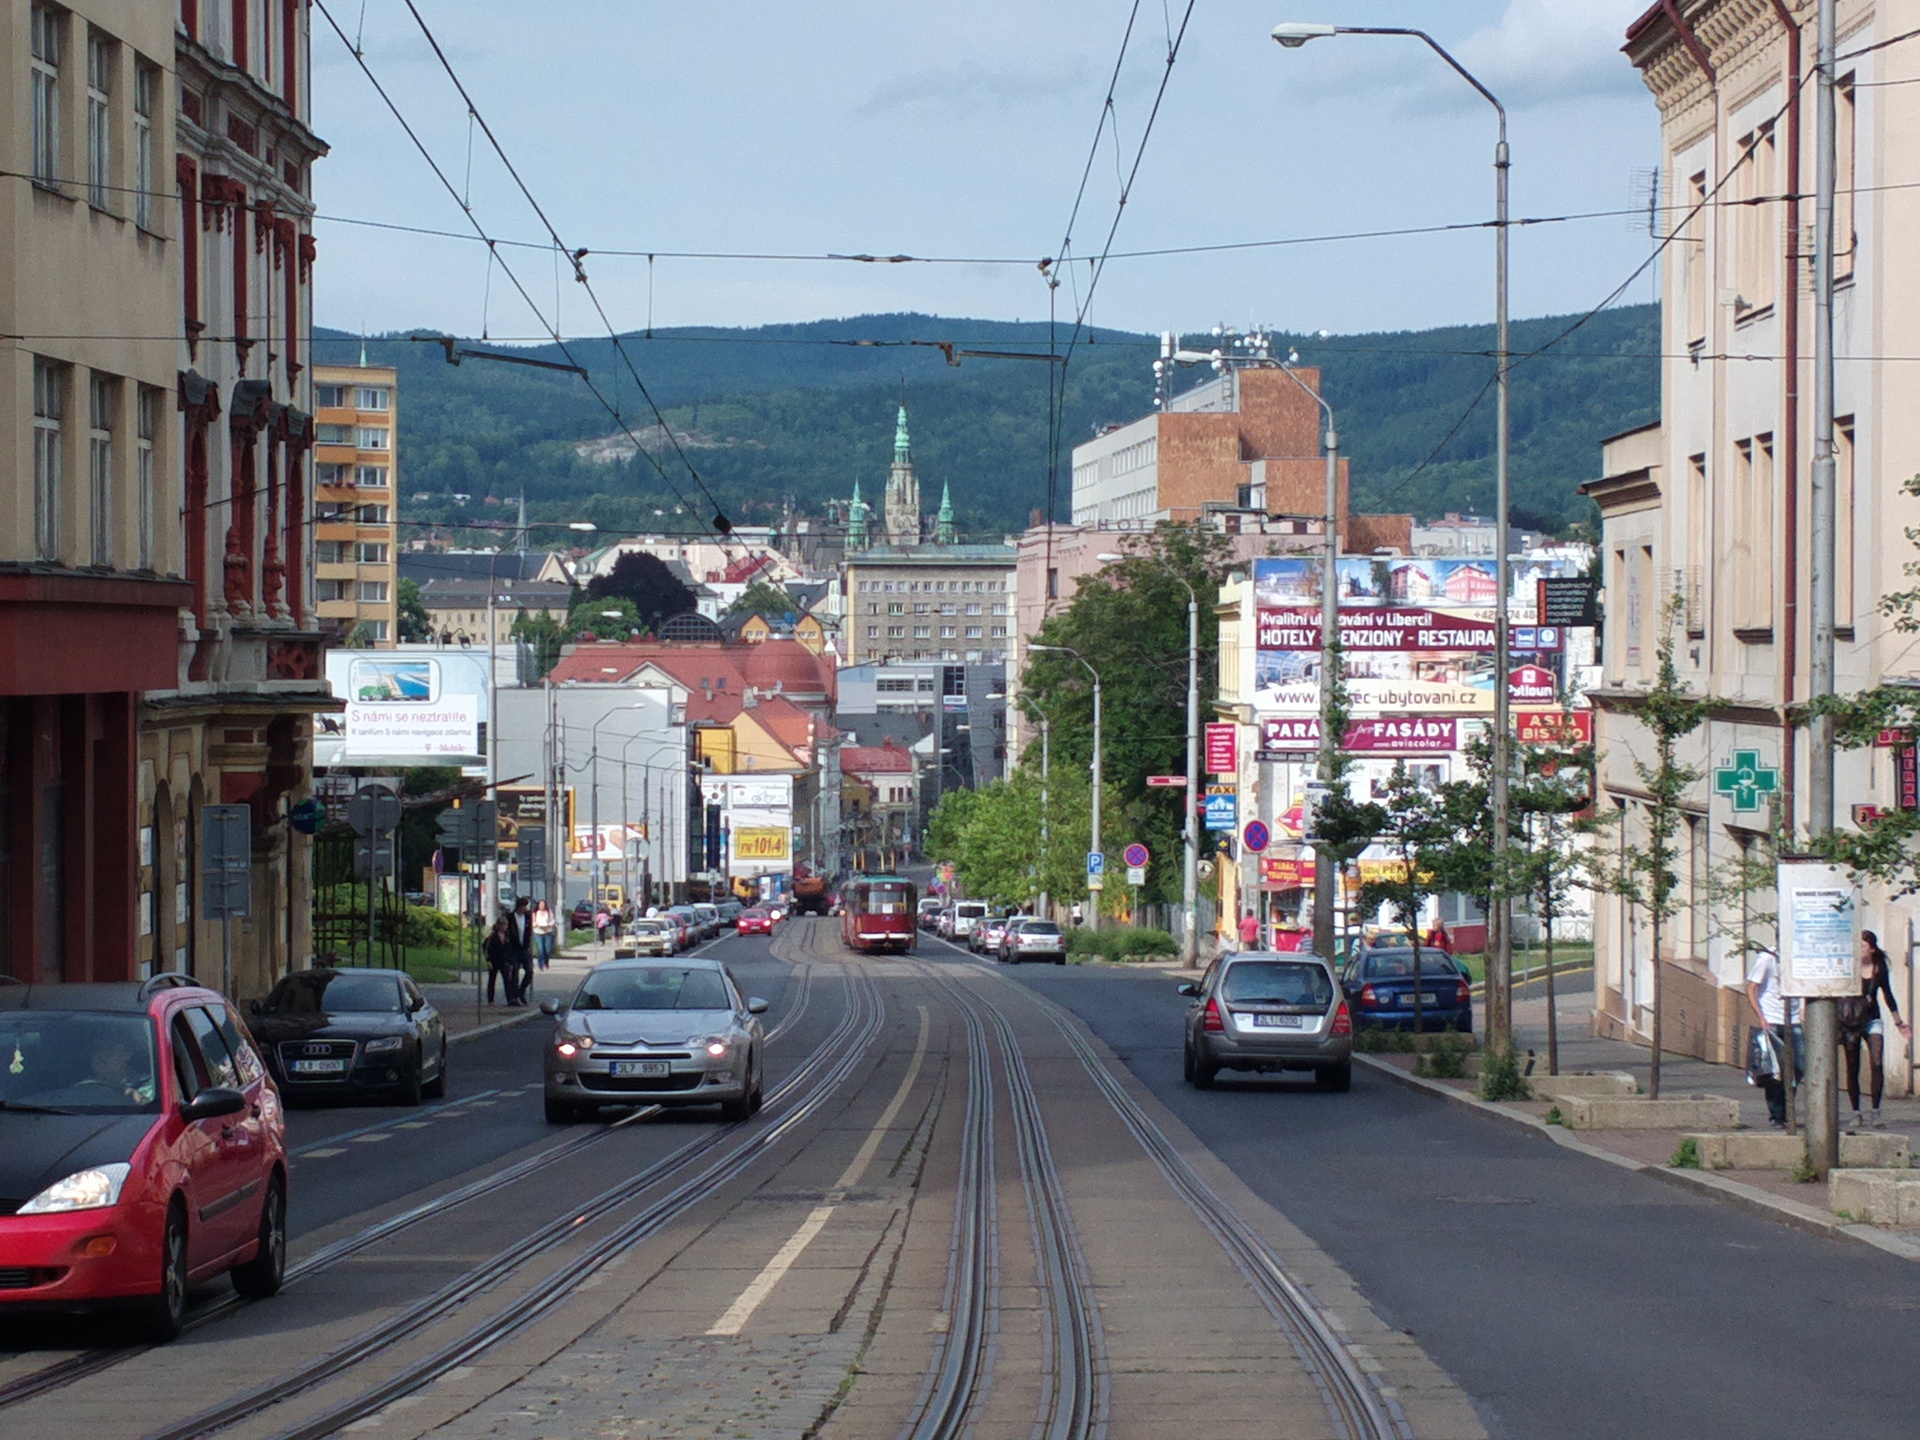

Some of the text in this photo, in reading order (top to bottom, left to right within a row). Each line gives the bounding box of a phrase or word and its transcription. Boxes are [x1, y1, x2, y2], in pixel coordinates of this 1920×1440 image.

[1097, 519, 1147, 532] HOT
[1260, 612, 1307, 626] Kvalitní
[1376, 615, 1383, 626] v
[1386, 612, 1433, 627] Liberci!
[1473, 610, 1497, 620] +42
[1260, 629, 1317, 646] HOTELY
[1338, 629, 1405, 646] ENZIONY
[351, 710, 360, 723] S
[363, 711, 393, 723] námi
[395, 713, 409, 723] se
[1267, 719, 1320, 738] PARÁ
[1373, 719, 1453, 738] FASÁDY
[1206, 785, 1236, 794] TAXI
[1090, 855, 1101, 868] P
[618, 1064, 636, 1074] 3L7
